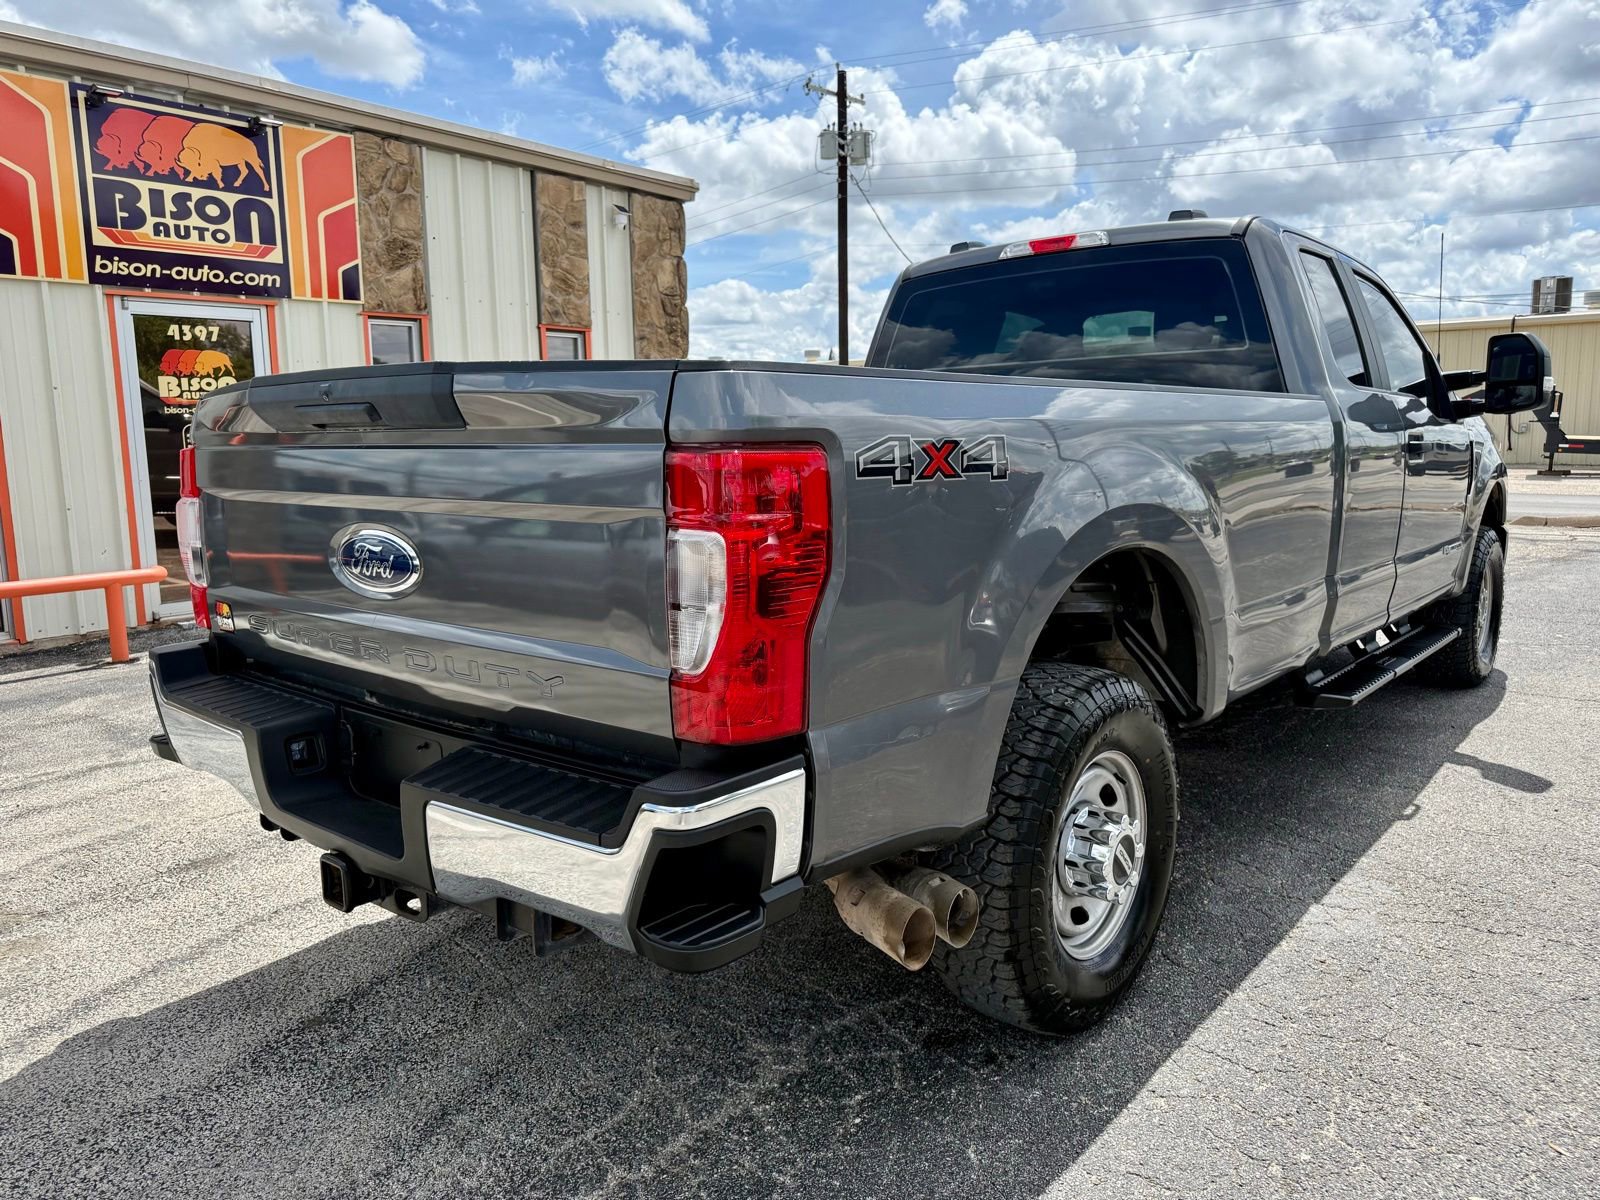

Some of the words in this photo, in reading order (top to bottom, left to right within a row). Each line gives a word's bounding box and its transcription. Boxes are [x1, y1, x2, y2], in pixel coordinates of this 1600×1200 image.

[92, 177, 277, 246] BISON
[152, 221, 231, 244] AUTO
[94, 254, 281, 288] bison-auto.com
[166, 324, 220, 342] 4397
[350, 541, 395, 580] Ford
[247, 613, 391, 664] SUPER
[403, 646, 565, 698] DUTY
